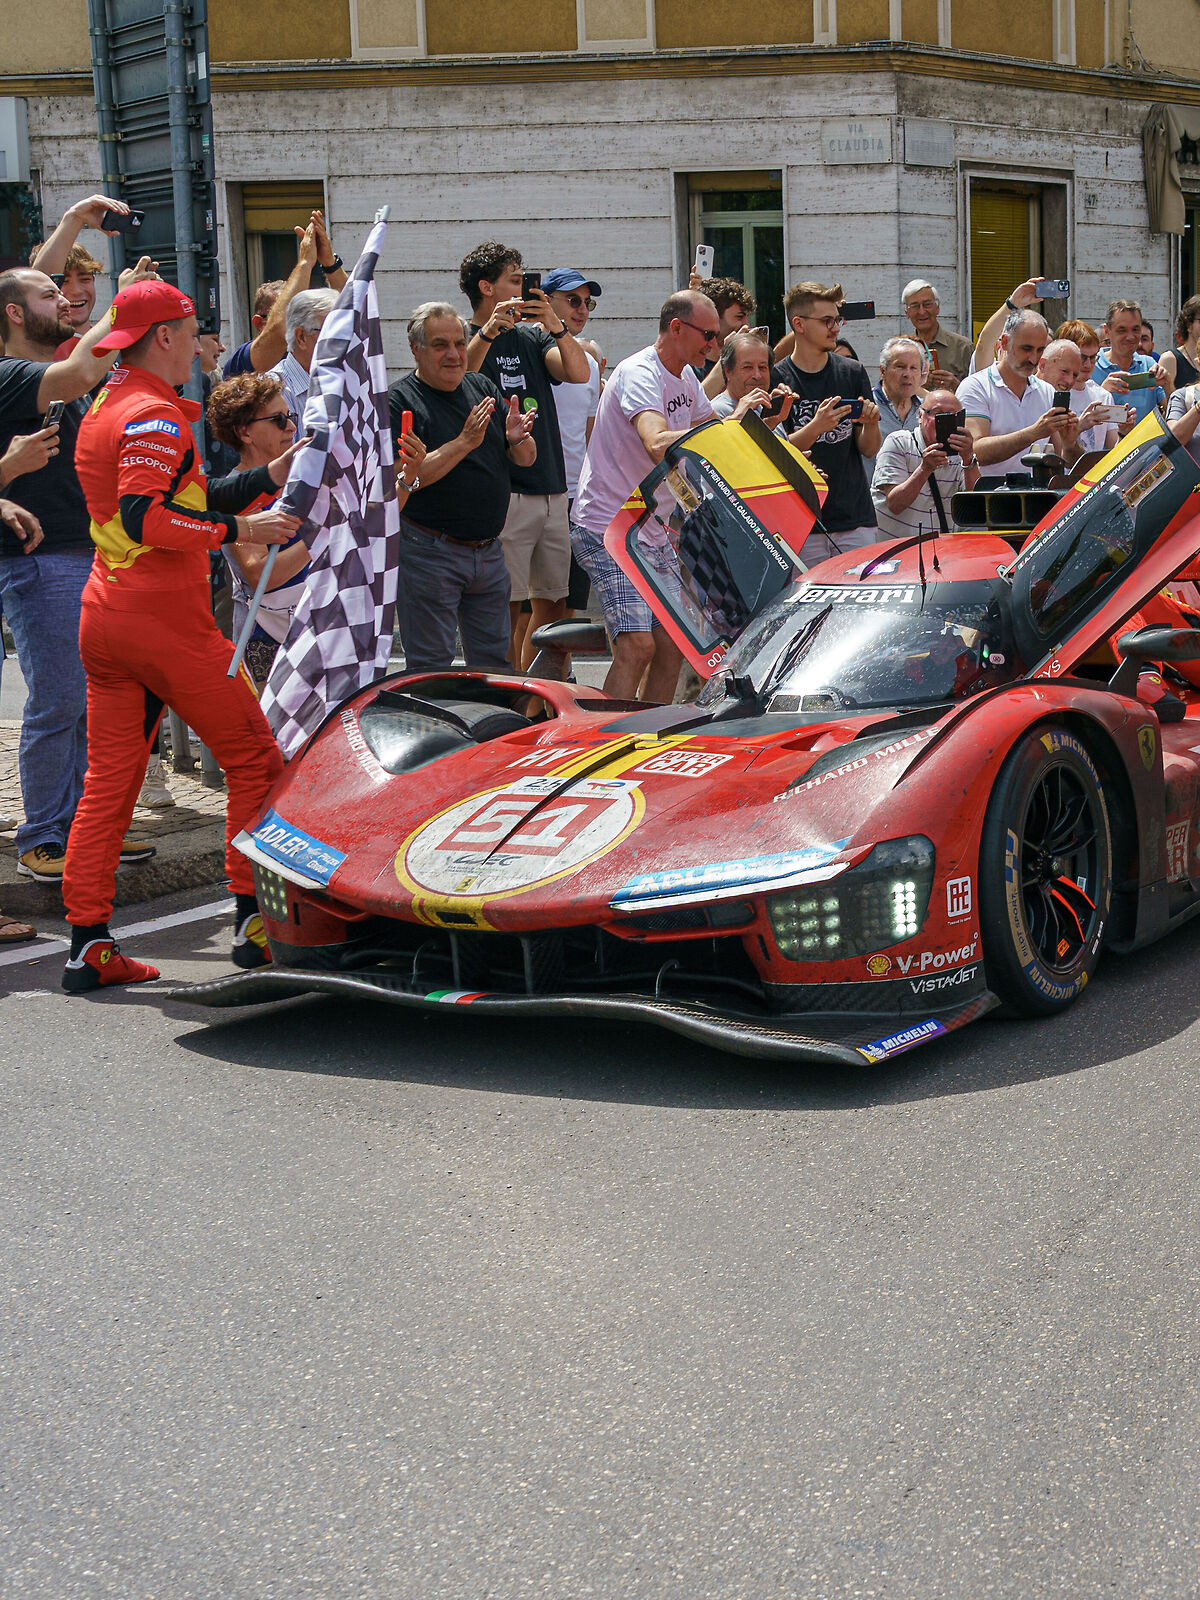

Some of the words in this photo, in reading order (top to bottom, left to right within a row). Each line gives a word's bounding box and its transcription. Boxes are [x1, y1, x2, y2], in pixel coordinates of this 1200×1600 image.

[848, 123, 864, 133] VIA
[829, 138, 884, 152] CLAUDIA
[134, 440, 177, 457] Santander
[1068, 491, 1094, 517] CALADO
[1104, 447, 1140, 481] GIOVINAZZI
[716, 480, 731, 497] GUIDI
[735, 505, 756, 529] CALADO
[761, 538, 789, 571] GIOVINAZZI
[340, 708, 364, 752] RICHARD
[505, 748, 586, 768] HY
[643, 760, 713, 774] CAR
[665, 751, 727, 764] HYPER
[773, 757, 869, 803] RICHARD
[875, 726, 940, 760] MILLE
[1060, 734, 1100, 783] MICHELIN
[252, 823, 310, 858] ADLER
[451, 800, 590, 849] 51
[1010, 893, 1022, 930] SPORT
[896, 942, 977, 975] V-Power
[1015, 932, 1029, 957] PILOT
[910, 964, 978, 994] VISTAJET
[1028, 966, 1076, 1001] MICHELIN
[880, 1021, 938, 1051] MICHELIN
